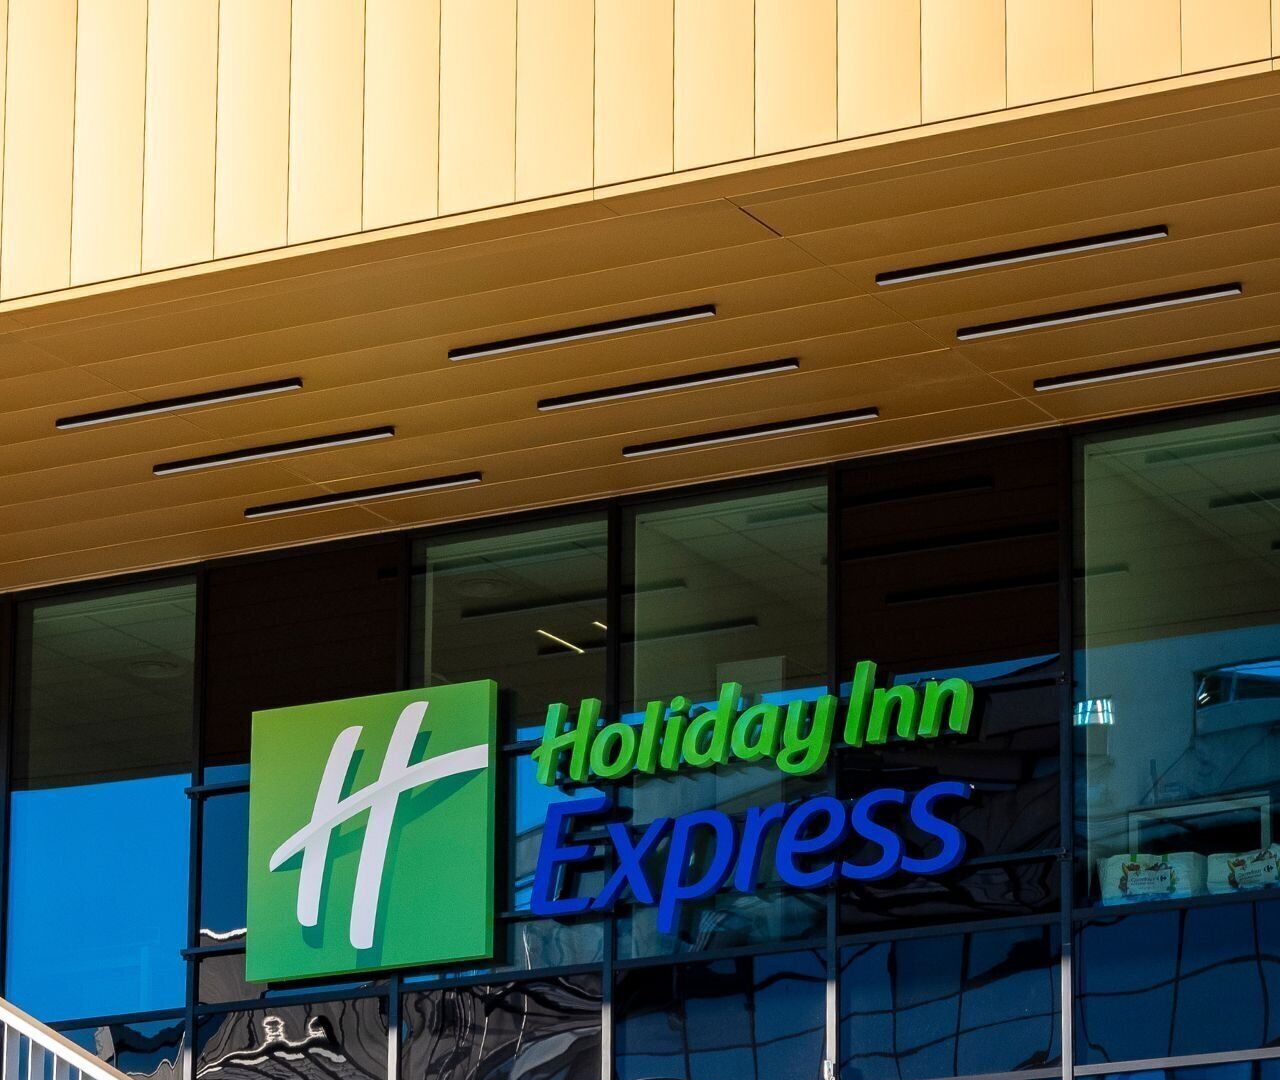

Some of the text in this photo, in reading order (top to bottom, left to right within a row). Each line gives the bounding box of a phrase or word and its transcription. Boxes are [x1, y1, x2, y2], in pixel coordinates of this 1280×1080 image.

[531, 660, 974, 786] Holiday Inn
[530, 781, 971, 935] Express
